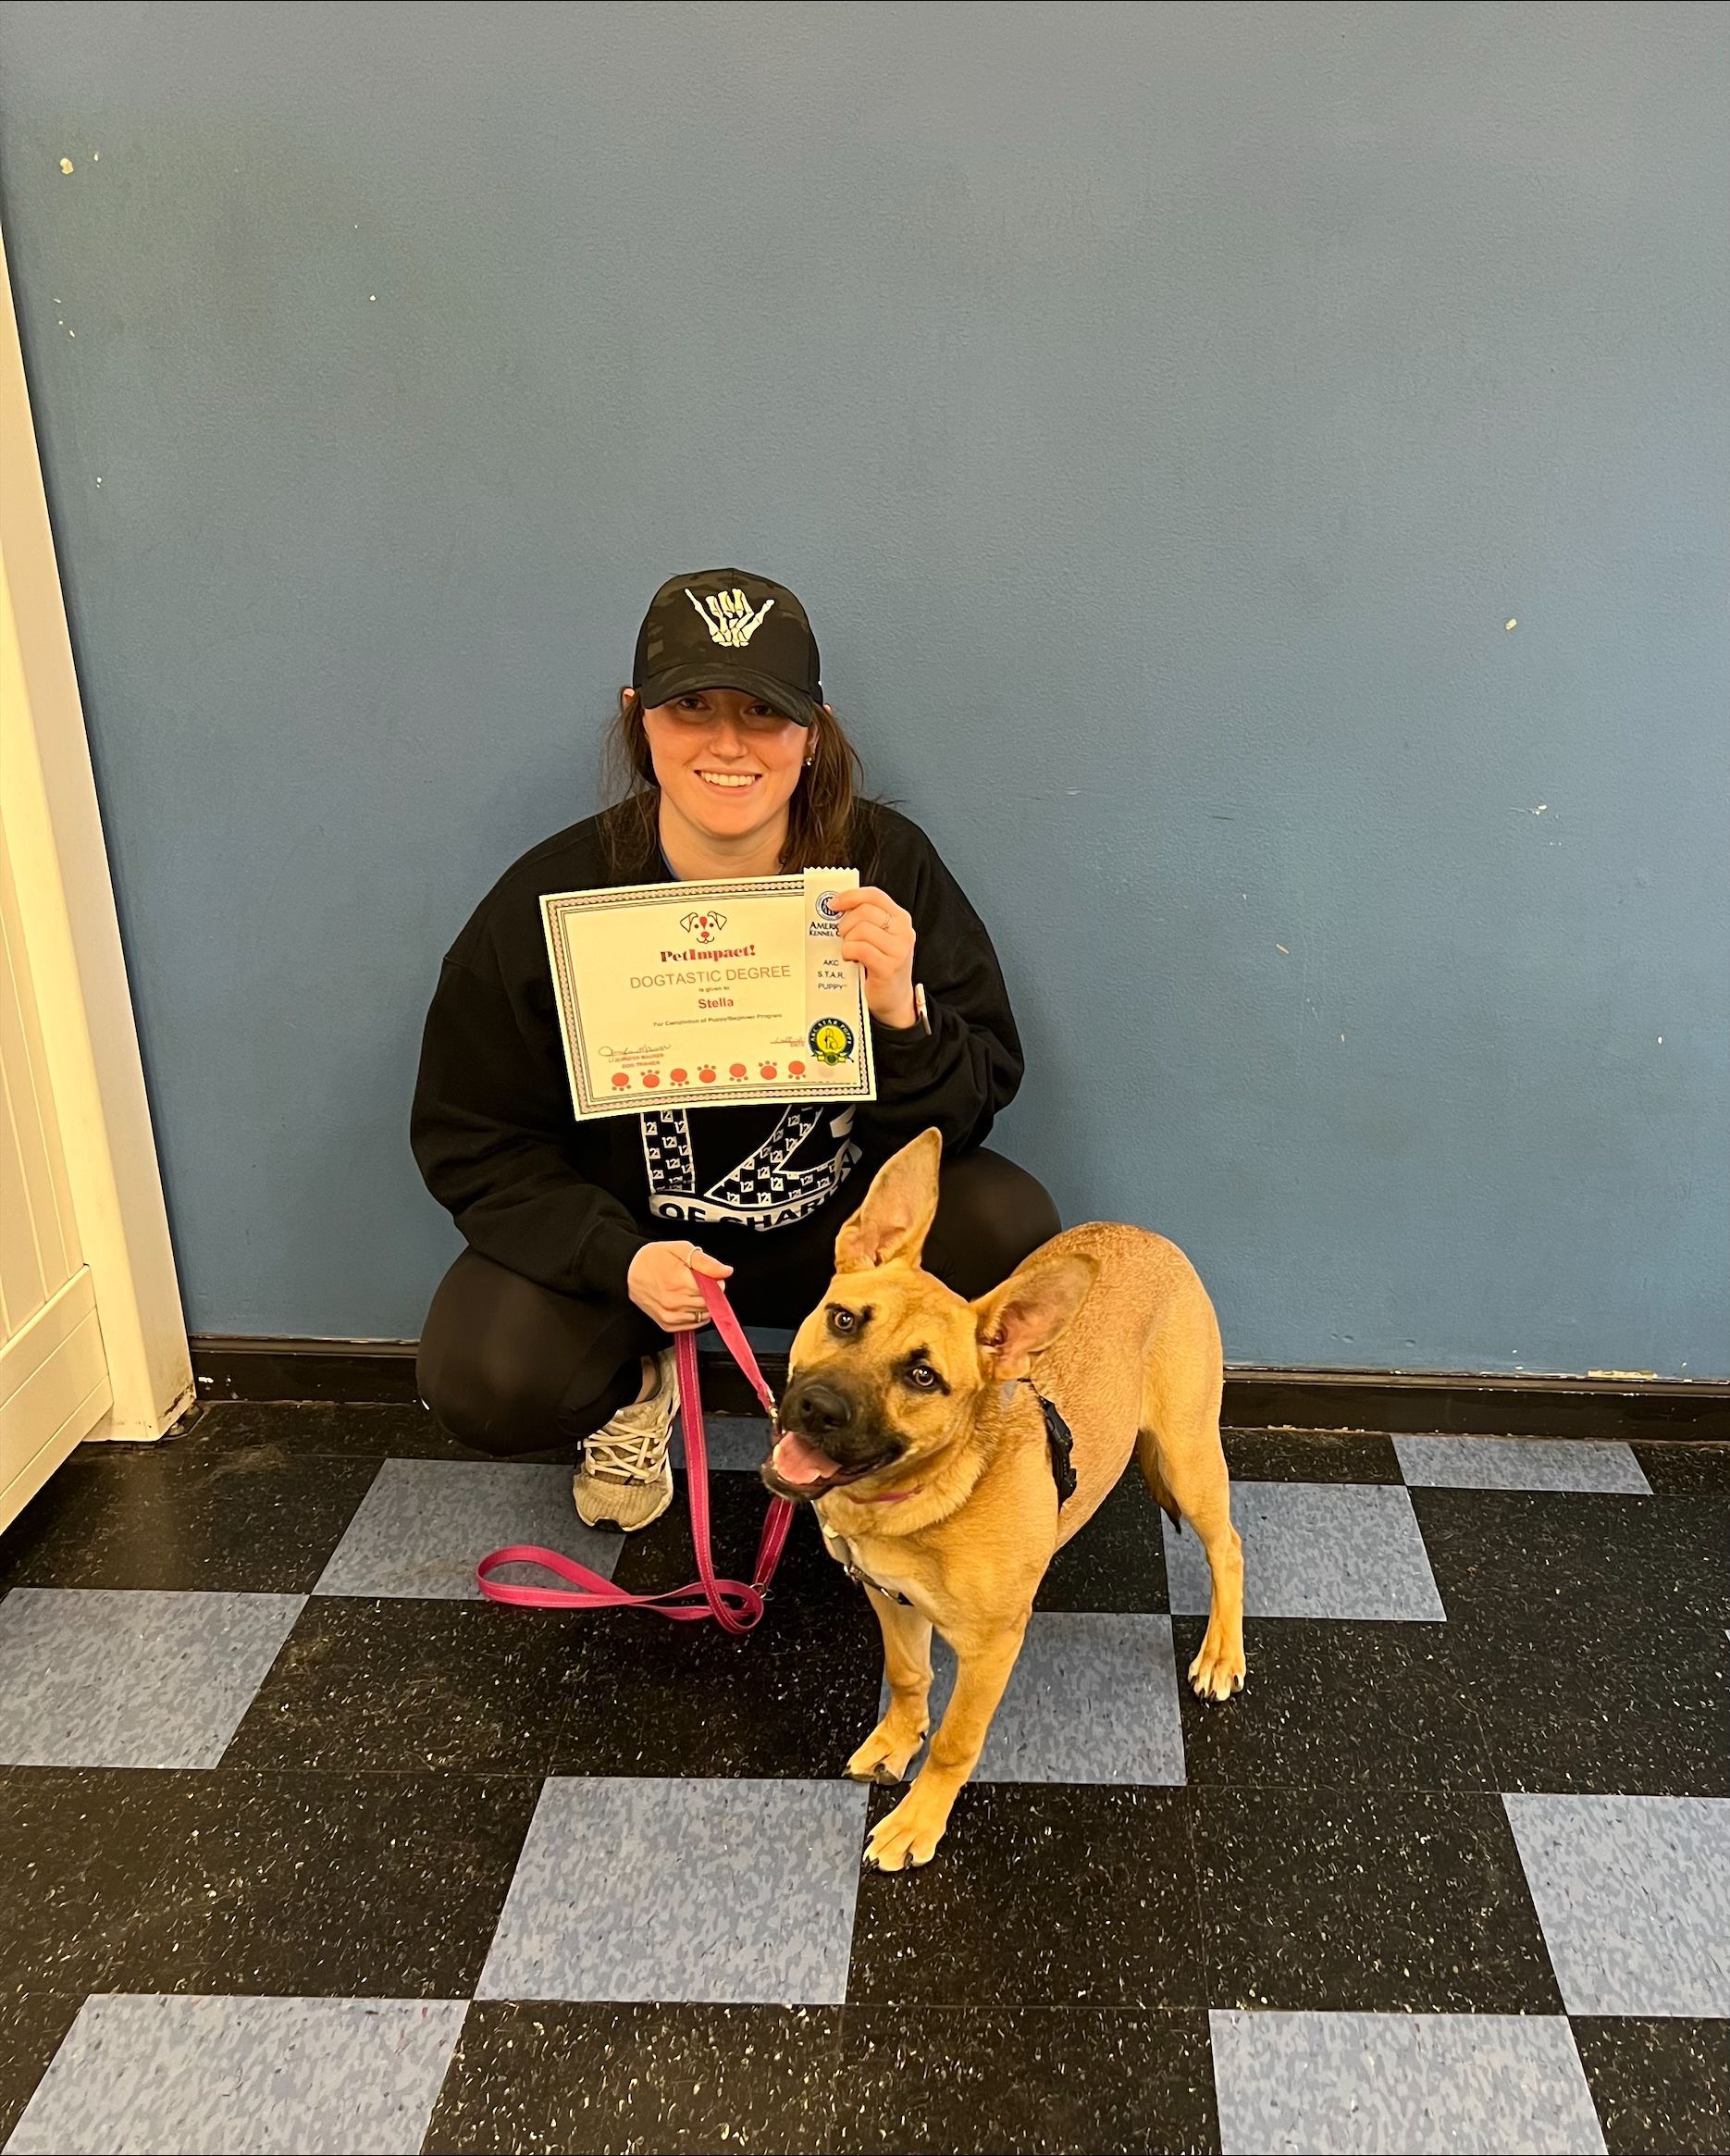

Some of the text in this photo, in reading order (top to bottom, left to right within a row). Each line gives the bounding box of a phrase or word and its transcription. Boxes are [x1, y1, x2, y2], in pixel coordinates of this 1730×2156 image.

[660, 944, 756, 962] PetImpact!
[630, 965, 792, 989] DOGTASTIC DEGREE
[698, 997, 735, 1010] Stella
